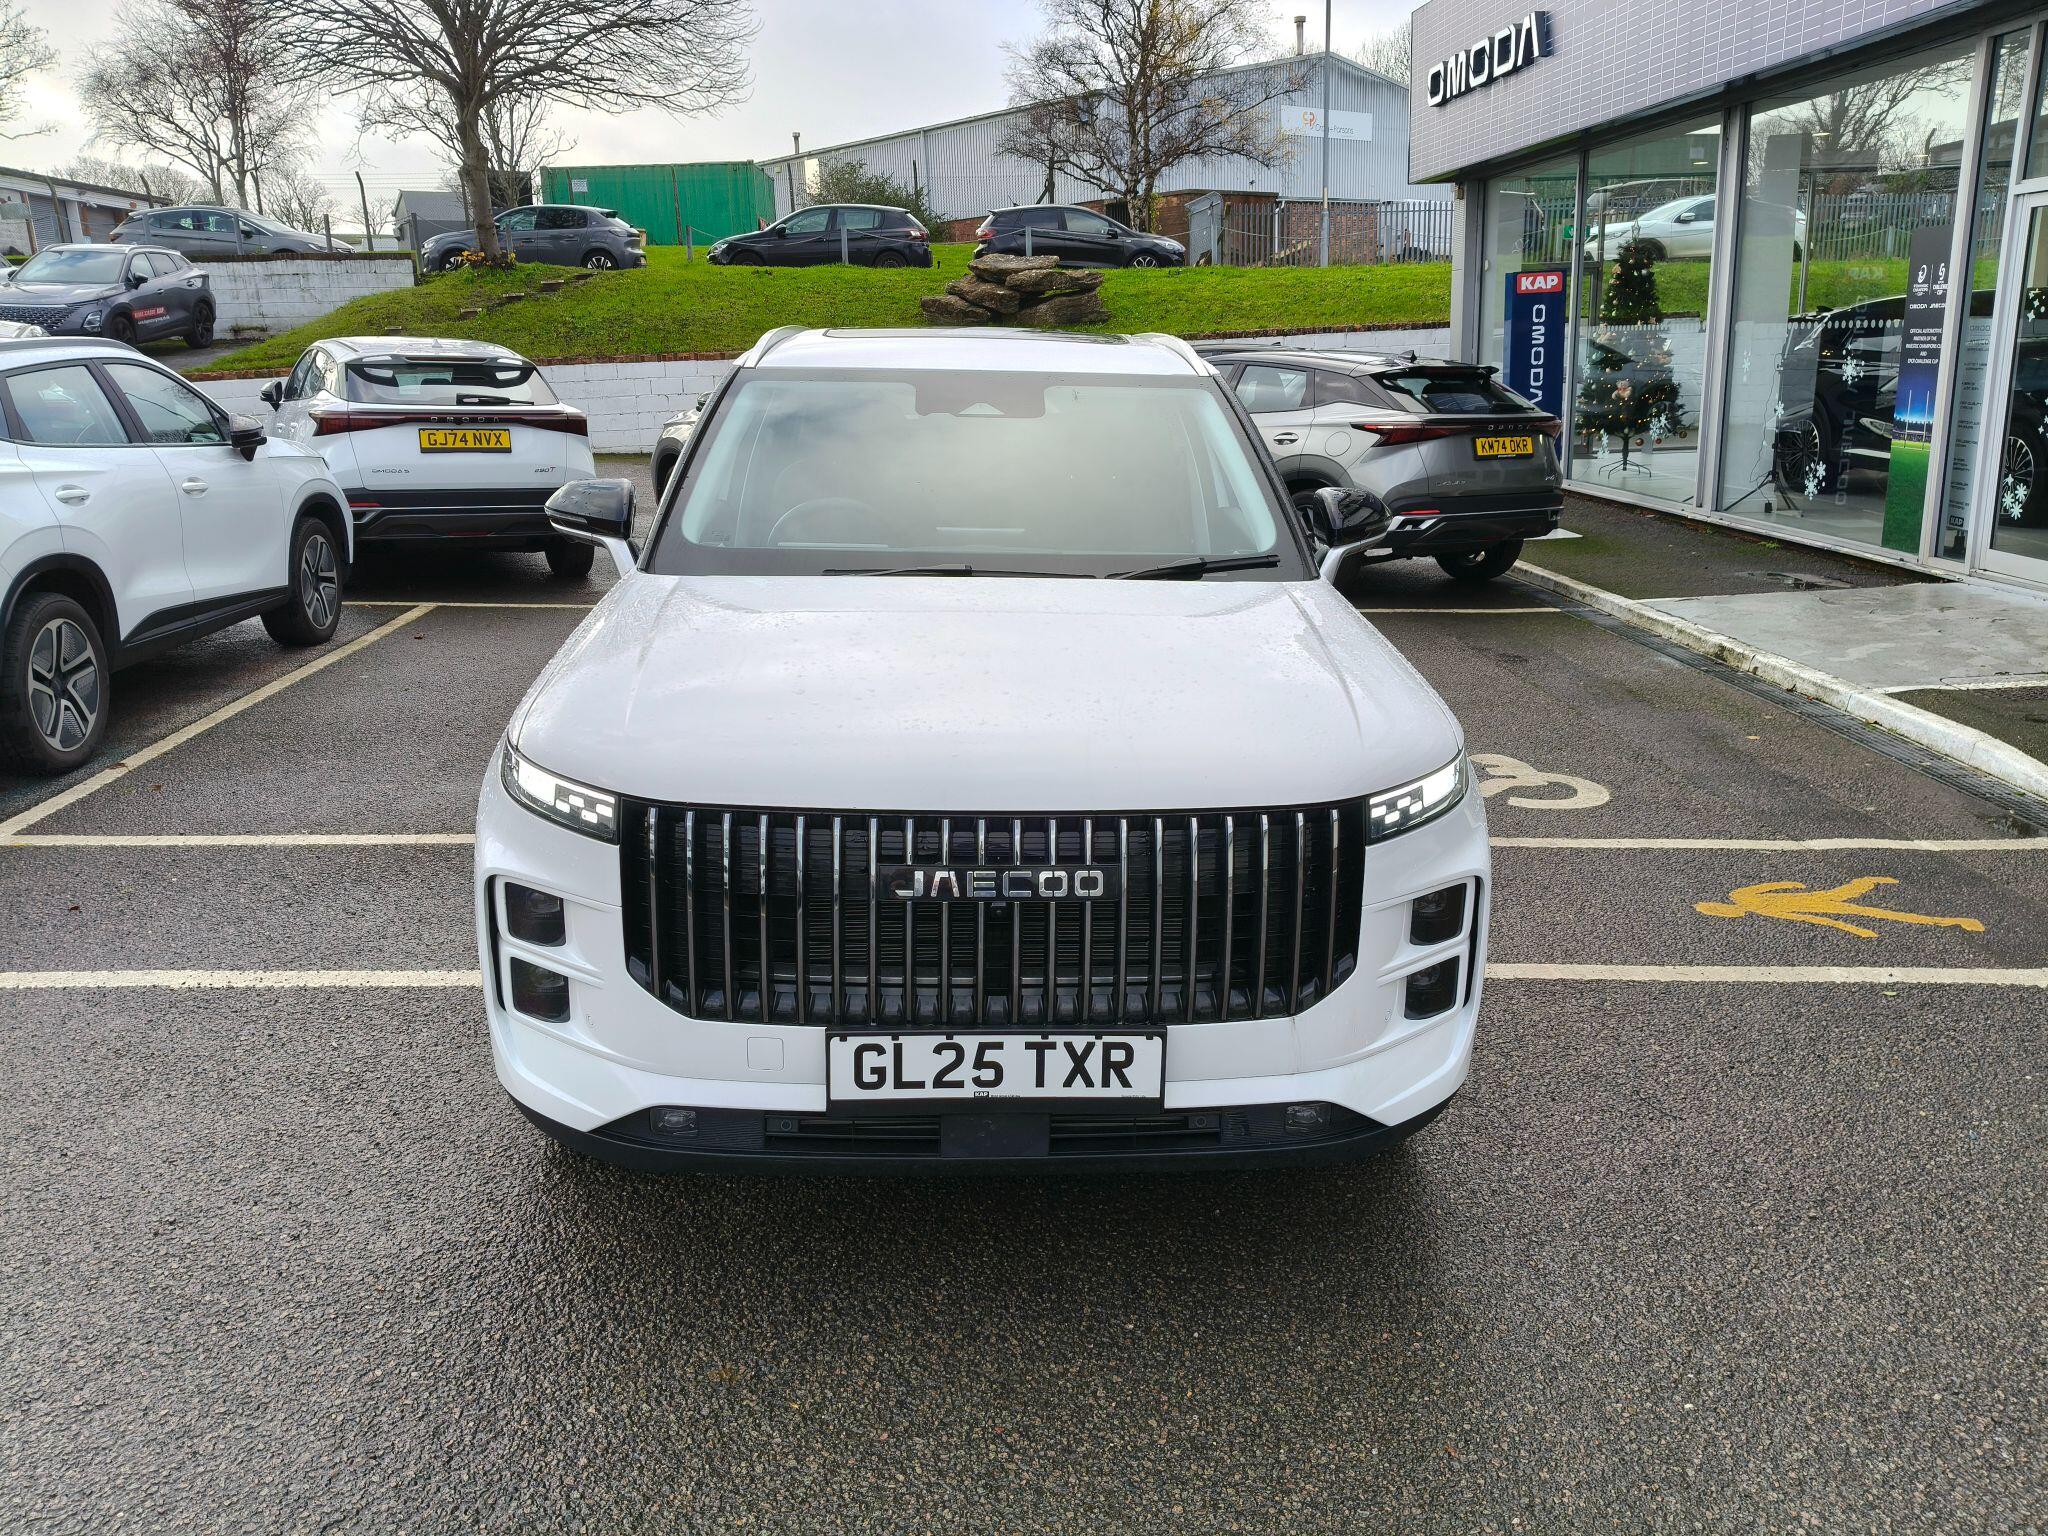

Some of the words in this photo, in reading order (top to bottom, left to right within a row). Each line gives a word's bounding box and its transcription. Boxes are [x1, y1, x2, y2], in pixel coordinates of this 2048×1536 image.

[1427, 11, 1541, 107] OMODA
[1521, 275, 1558, 290] KAP
[1529, 304, 1546, 404] OMODA
[427, 432, 469, 447] GJ74
[473, 432, 504, 447] NVX
[1481, 439, 1507, 453] KM74
[895, 870, 1104, 898] JAECOO
[854, 1041, 1005, 1091] GL25
[1024, 1041, 1135, 1089] TXR
